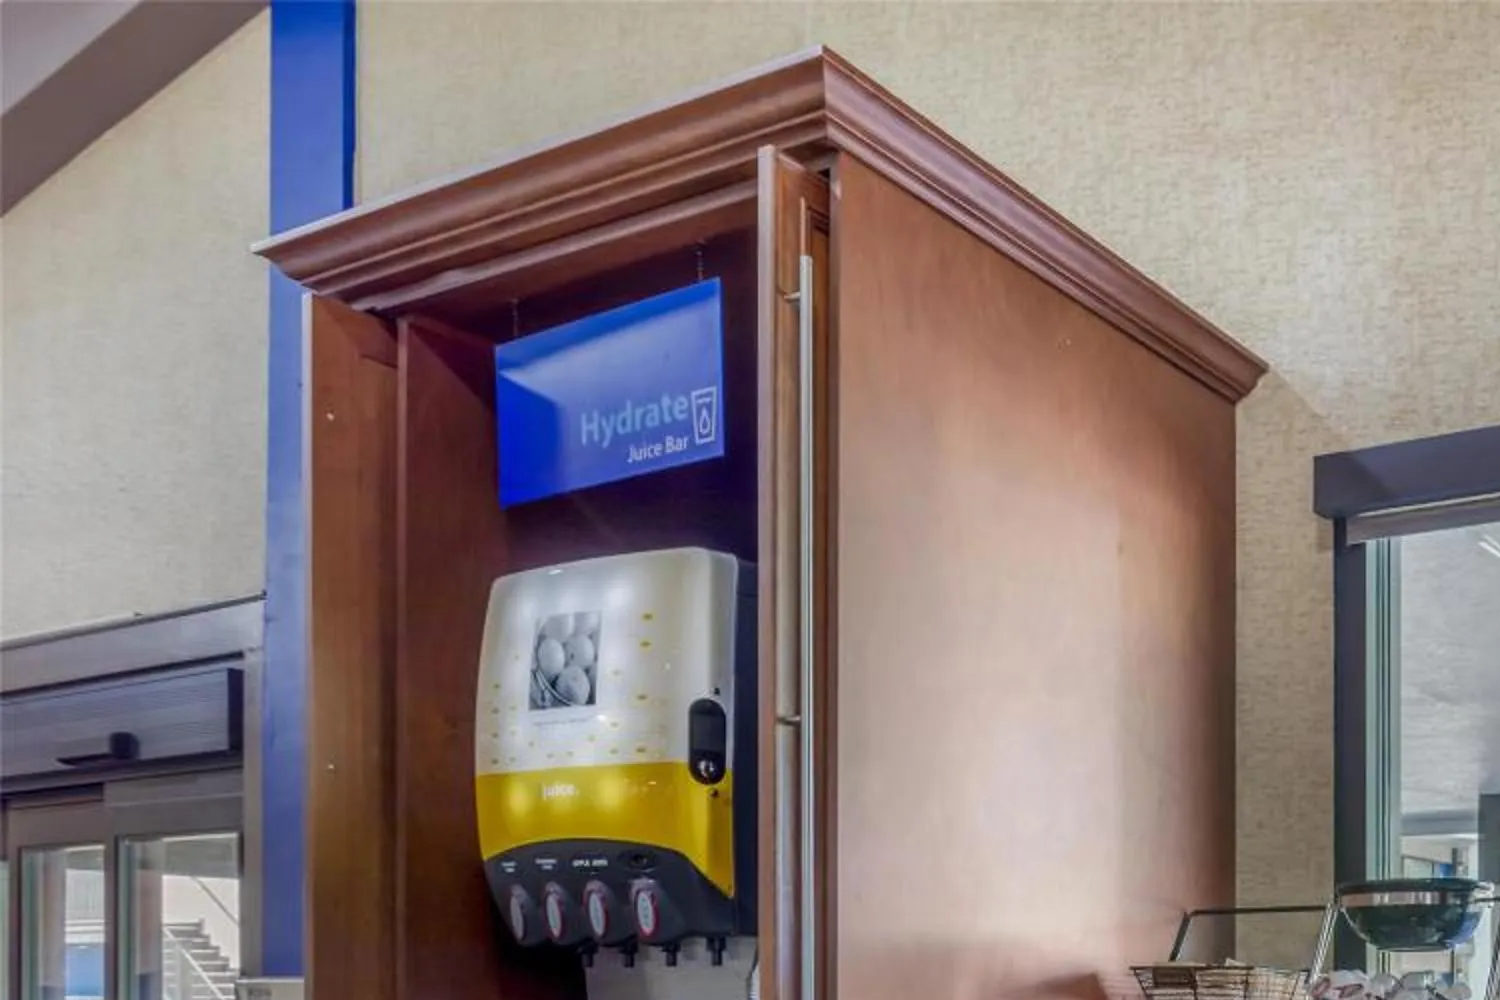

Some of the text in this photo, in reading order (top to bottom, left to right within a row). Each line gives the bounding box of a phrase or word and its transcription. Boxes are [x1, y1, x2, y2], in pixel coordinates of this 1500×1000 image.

[581, 391, 689, 448] Hydrate
[627, 434, 690, 463] Juice Bar
